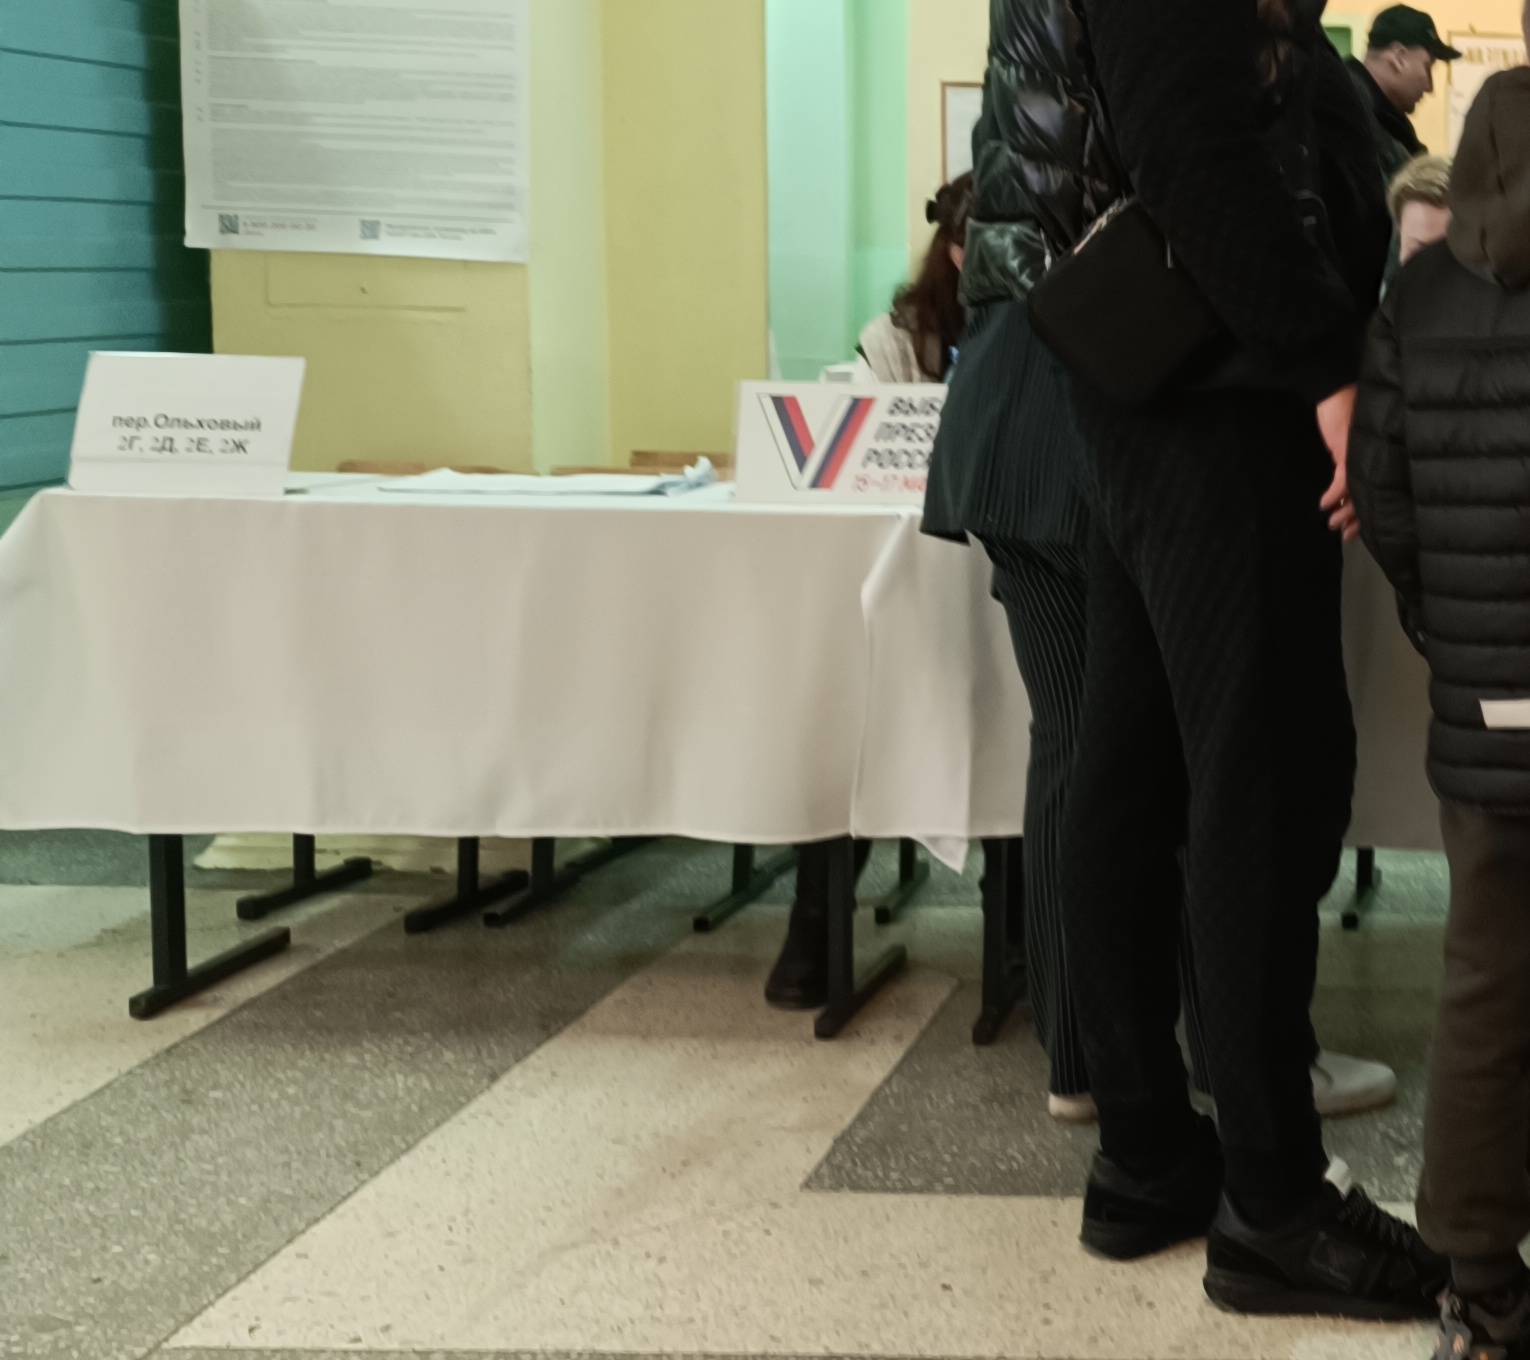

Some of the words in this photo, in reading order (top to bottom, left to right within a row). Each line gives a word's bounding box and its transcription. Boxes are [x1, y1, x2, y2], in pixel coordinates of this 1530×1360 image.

[887, 396, 942, 417] ВЫБ
[874, 422, 938, 443] ПРЕЗ
[861, 447, 928, 470] РОСС
